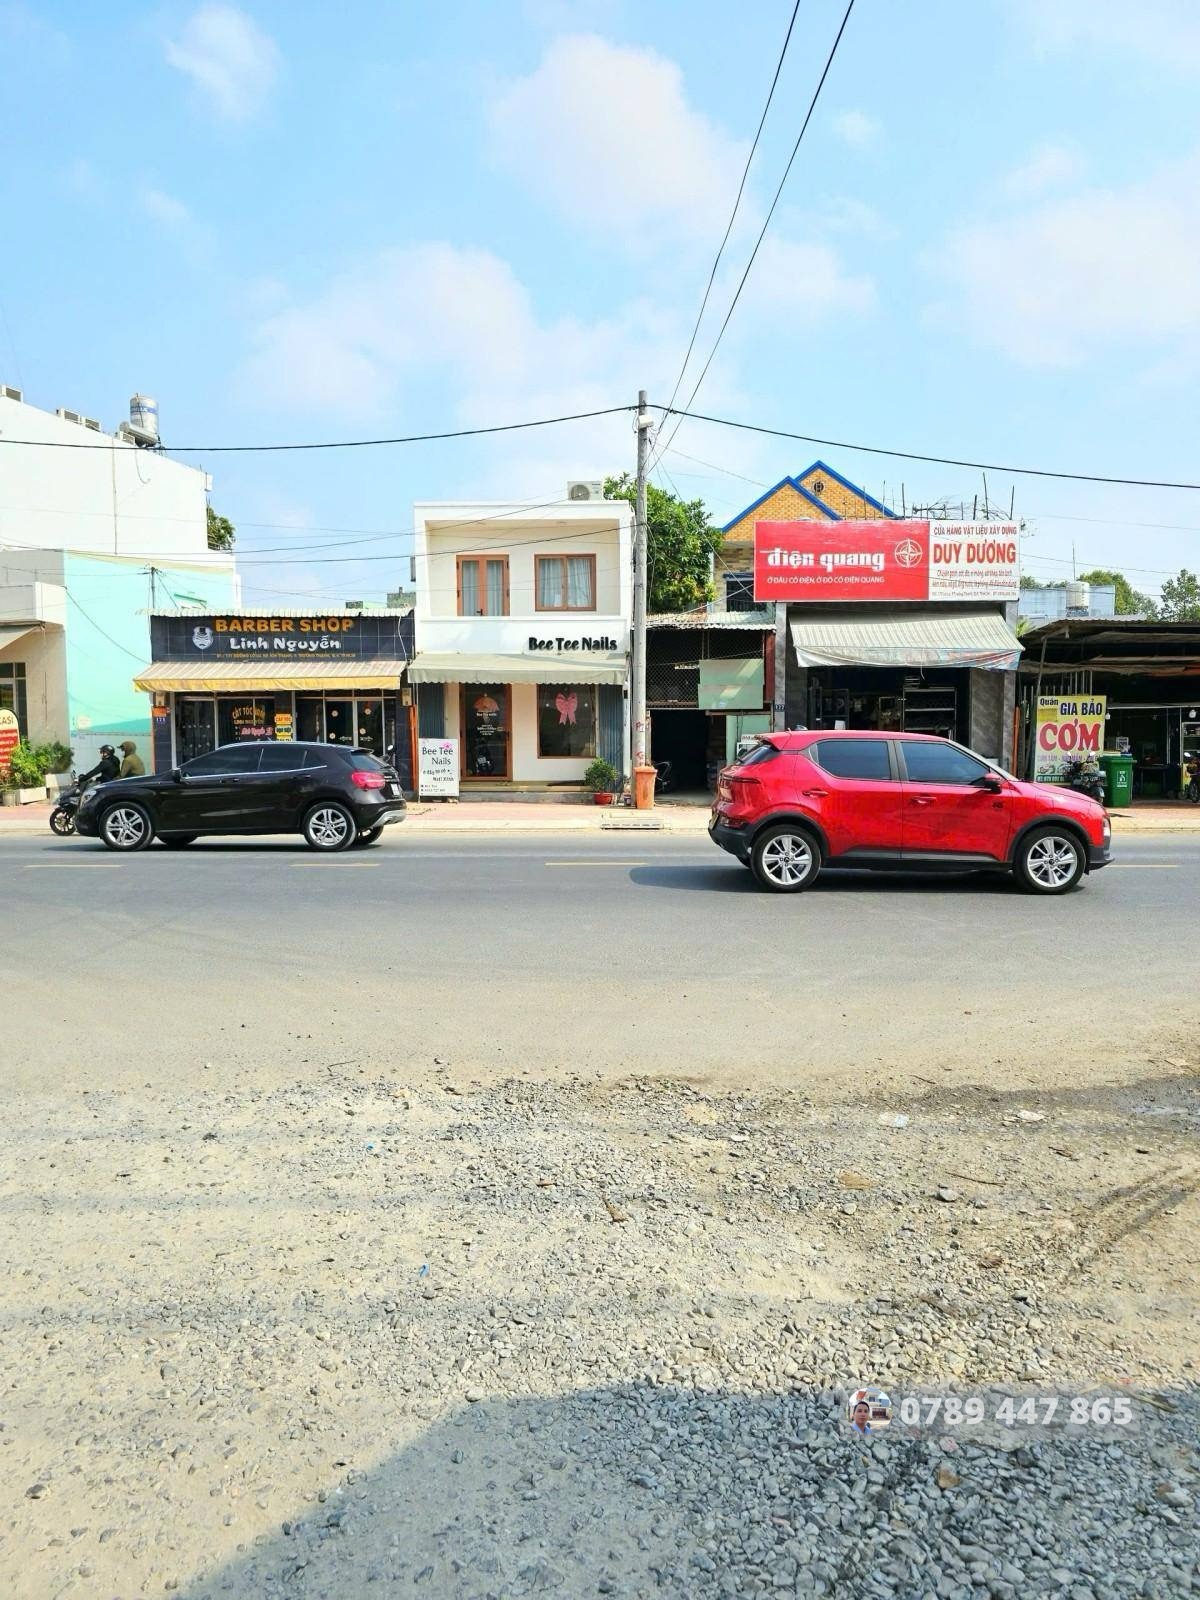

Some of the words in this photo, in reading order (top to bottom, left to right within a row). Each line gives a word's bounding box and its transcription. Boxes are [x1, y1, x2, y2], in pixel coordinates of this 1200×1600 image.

[760, 547, 814, 569] điện
[819, 553, 885, 573] quang
[933, 543, 962, 563] DUY
[215, 619, 294, 632] BARBER
[300, 617, 354, 632] SHOP
[229, 636, 268, 650] Linh
[273, 634, 341, 652] Nguyễn
[528, 636, 553, 651] Bee
[555, 637, 580, 651] Tee
[581, 636, 618, 651] Nails
[1060, 702, 1078, 716] GIA
[1081, 698, 1103, 716] BẢO
[1039, 718, 1101, 752] CƠM
[422, 746, 438, 755] Bee
[438, 746, 454, 755] Tee
[431, 757, 452, 765] Nails
